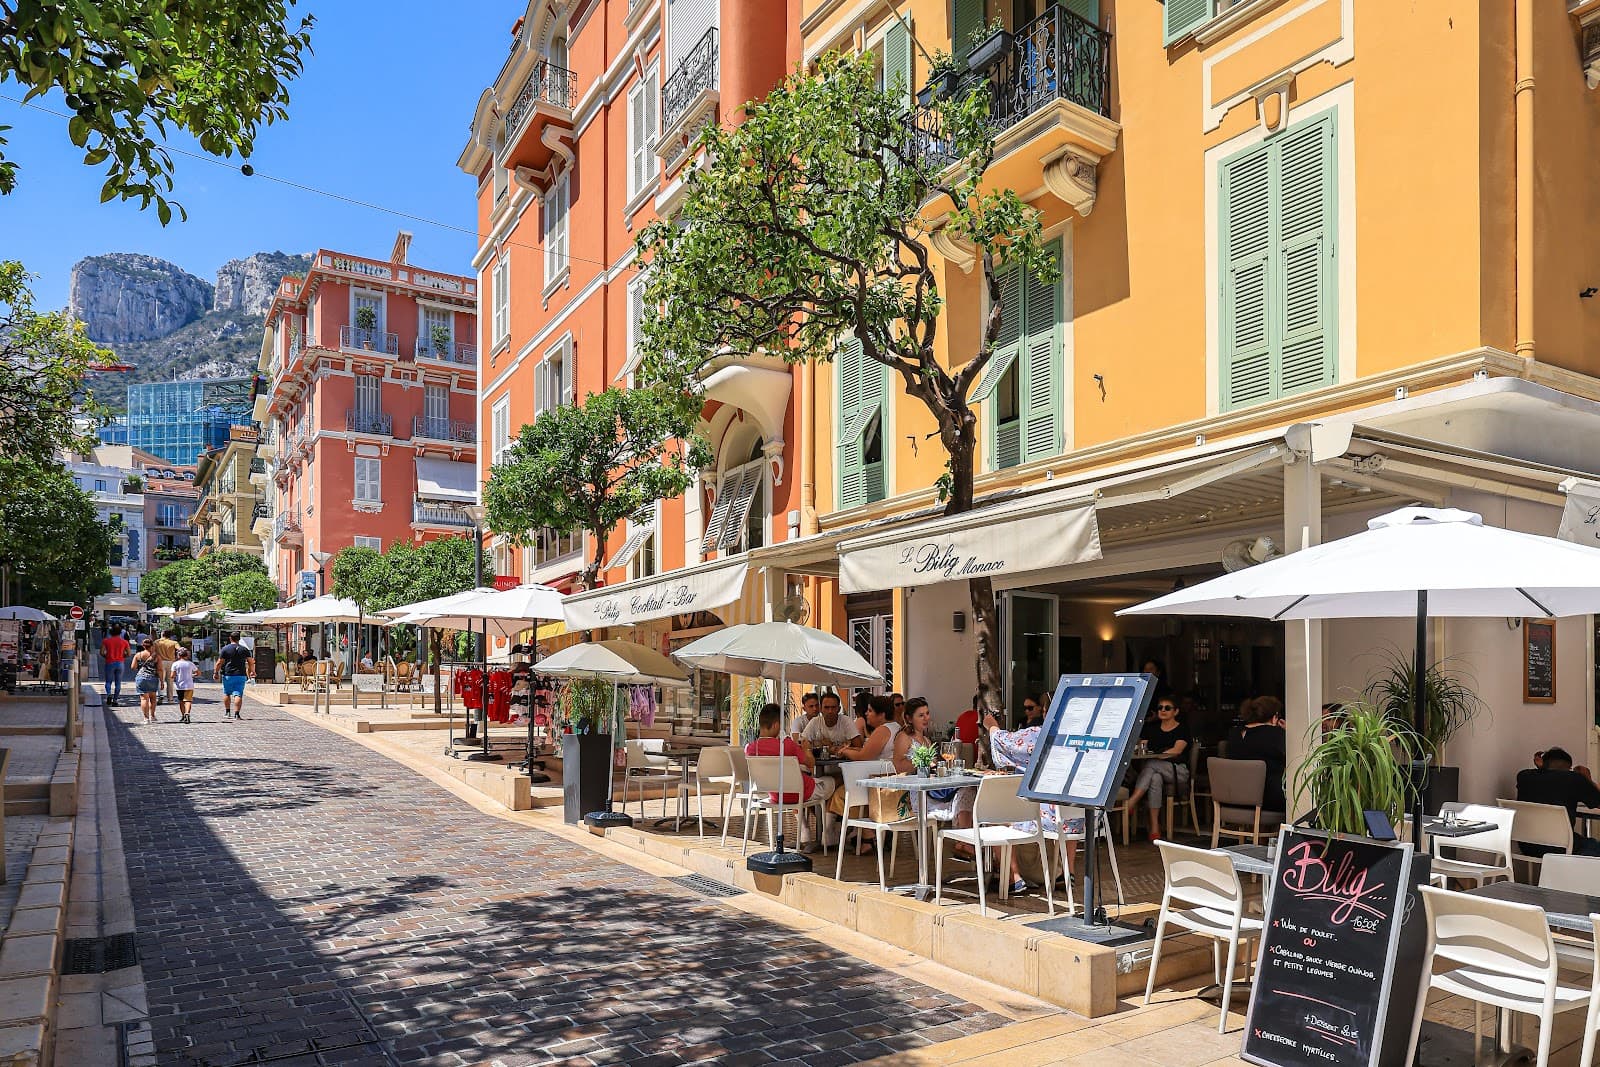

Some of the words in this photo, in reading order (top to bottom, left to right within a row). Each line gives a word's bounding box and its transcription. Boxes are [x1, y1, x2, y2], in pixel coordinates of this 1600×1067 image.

[899, 546, 914, 564] Le
[914, 543, 959, 578] Bilig
[957, 556, 1004, 575] Monaco
[631, 592, 668, 615] Cocktail
[674, 585, 697, 606] Bar
[1300, 926, 1308, 934] DE
[1303, 937, 1317, 947] OU
